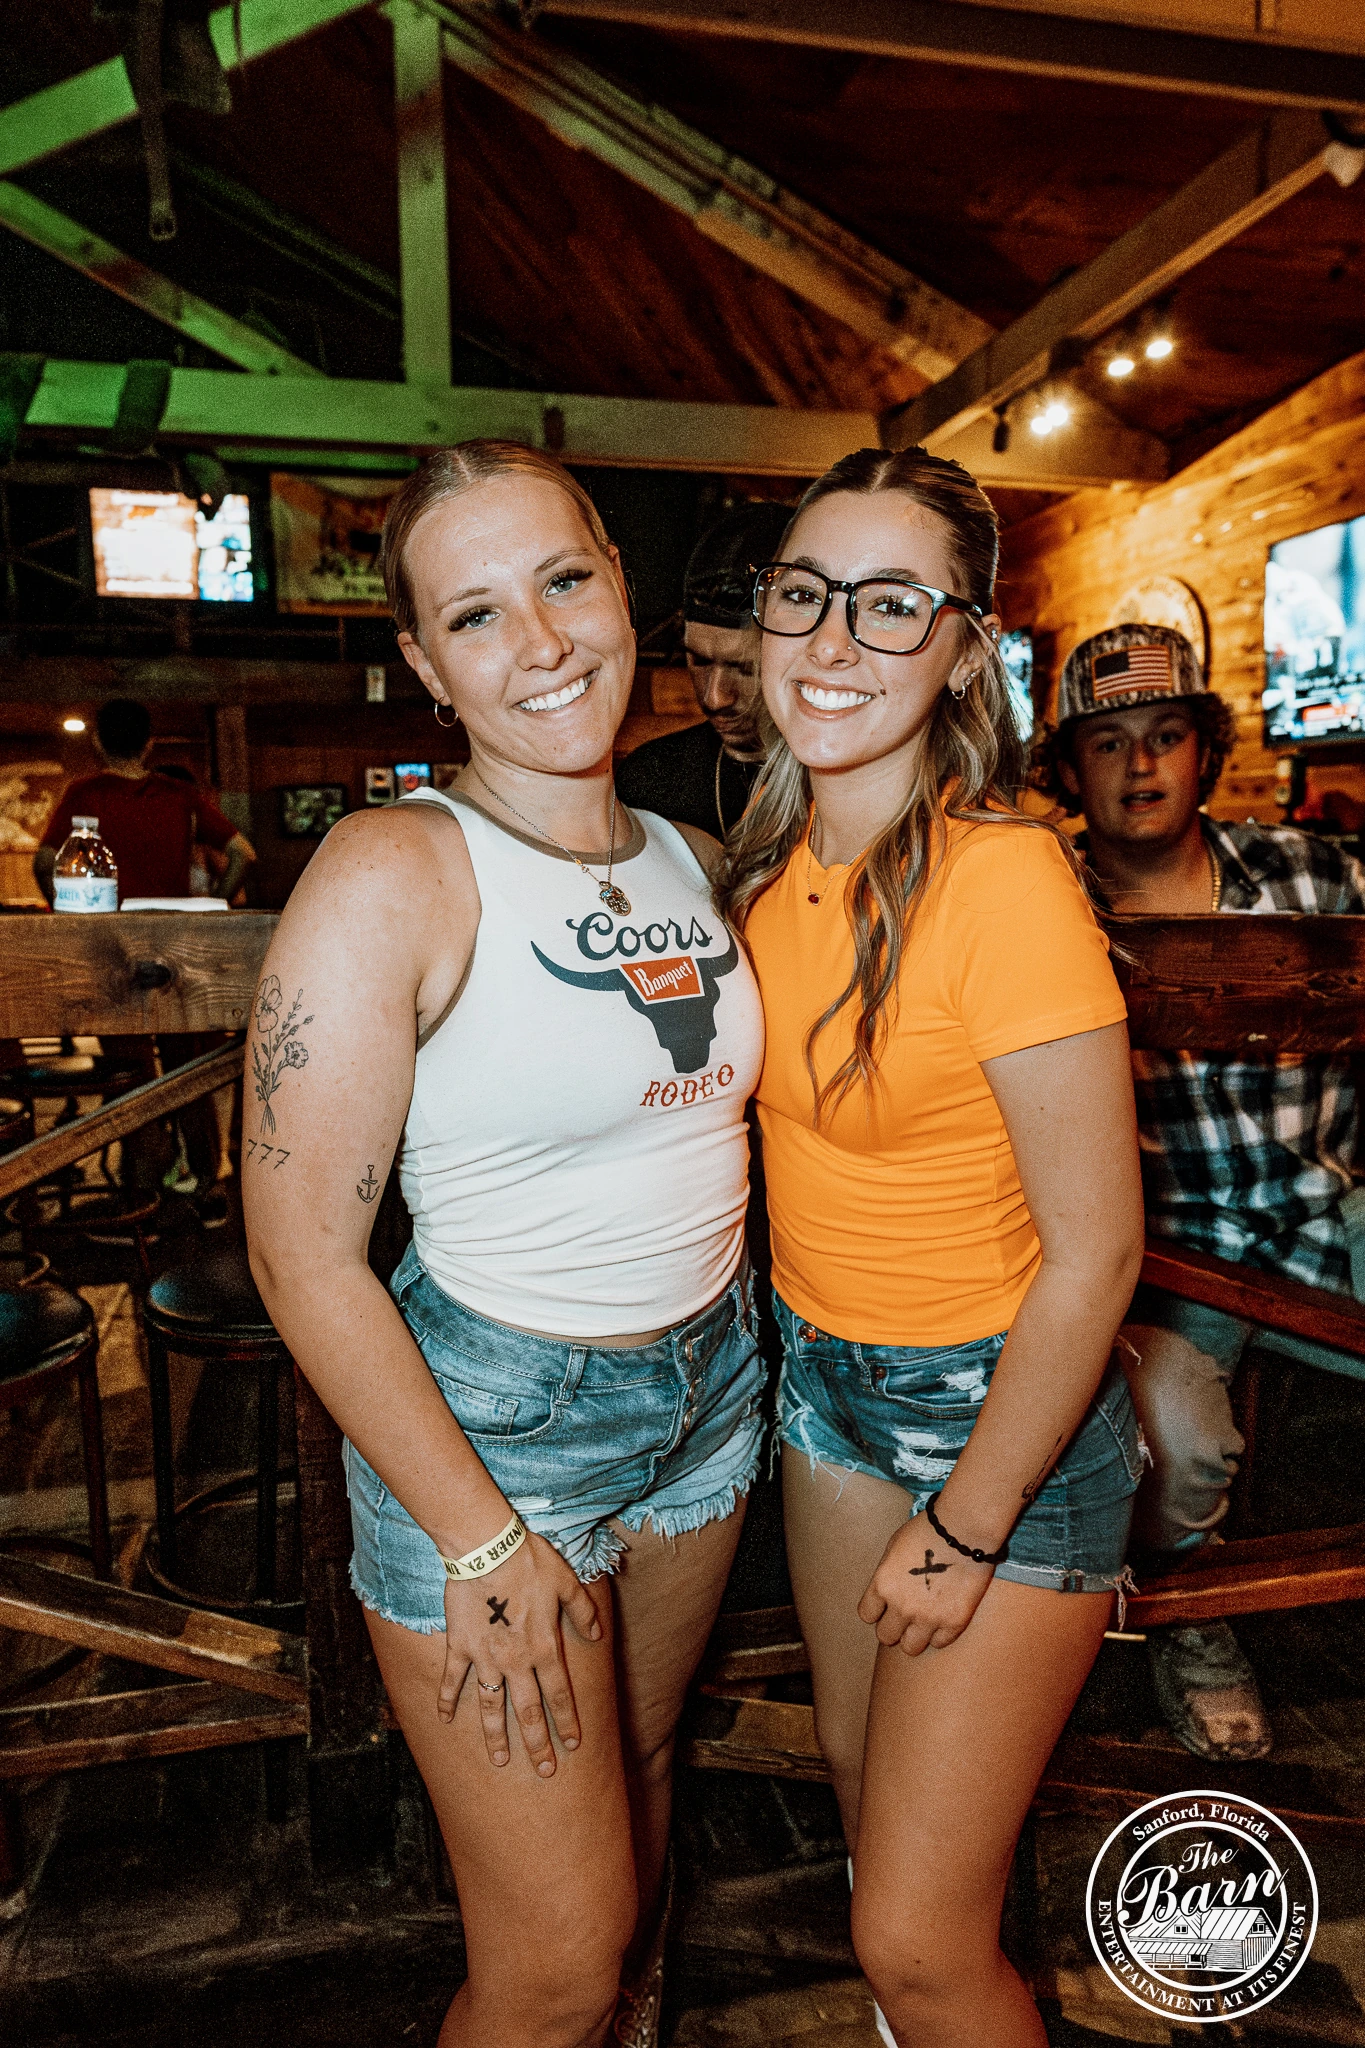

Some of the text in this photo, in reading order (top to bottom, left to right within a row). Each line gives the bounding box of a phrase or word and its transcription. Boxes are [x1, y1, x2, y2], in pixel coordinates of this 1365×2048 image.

[565, 911, 713, 961] Coors
[633, 961, 693, 997] Banquet
[640, 1063, 735, 1107] RODEO
[246, 1138, 291, 1170] 777
[486, 1518, 524, 1561] UNDER
